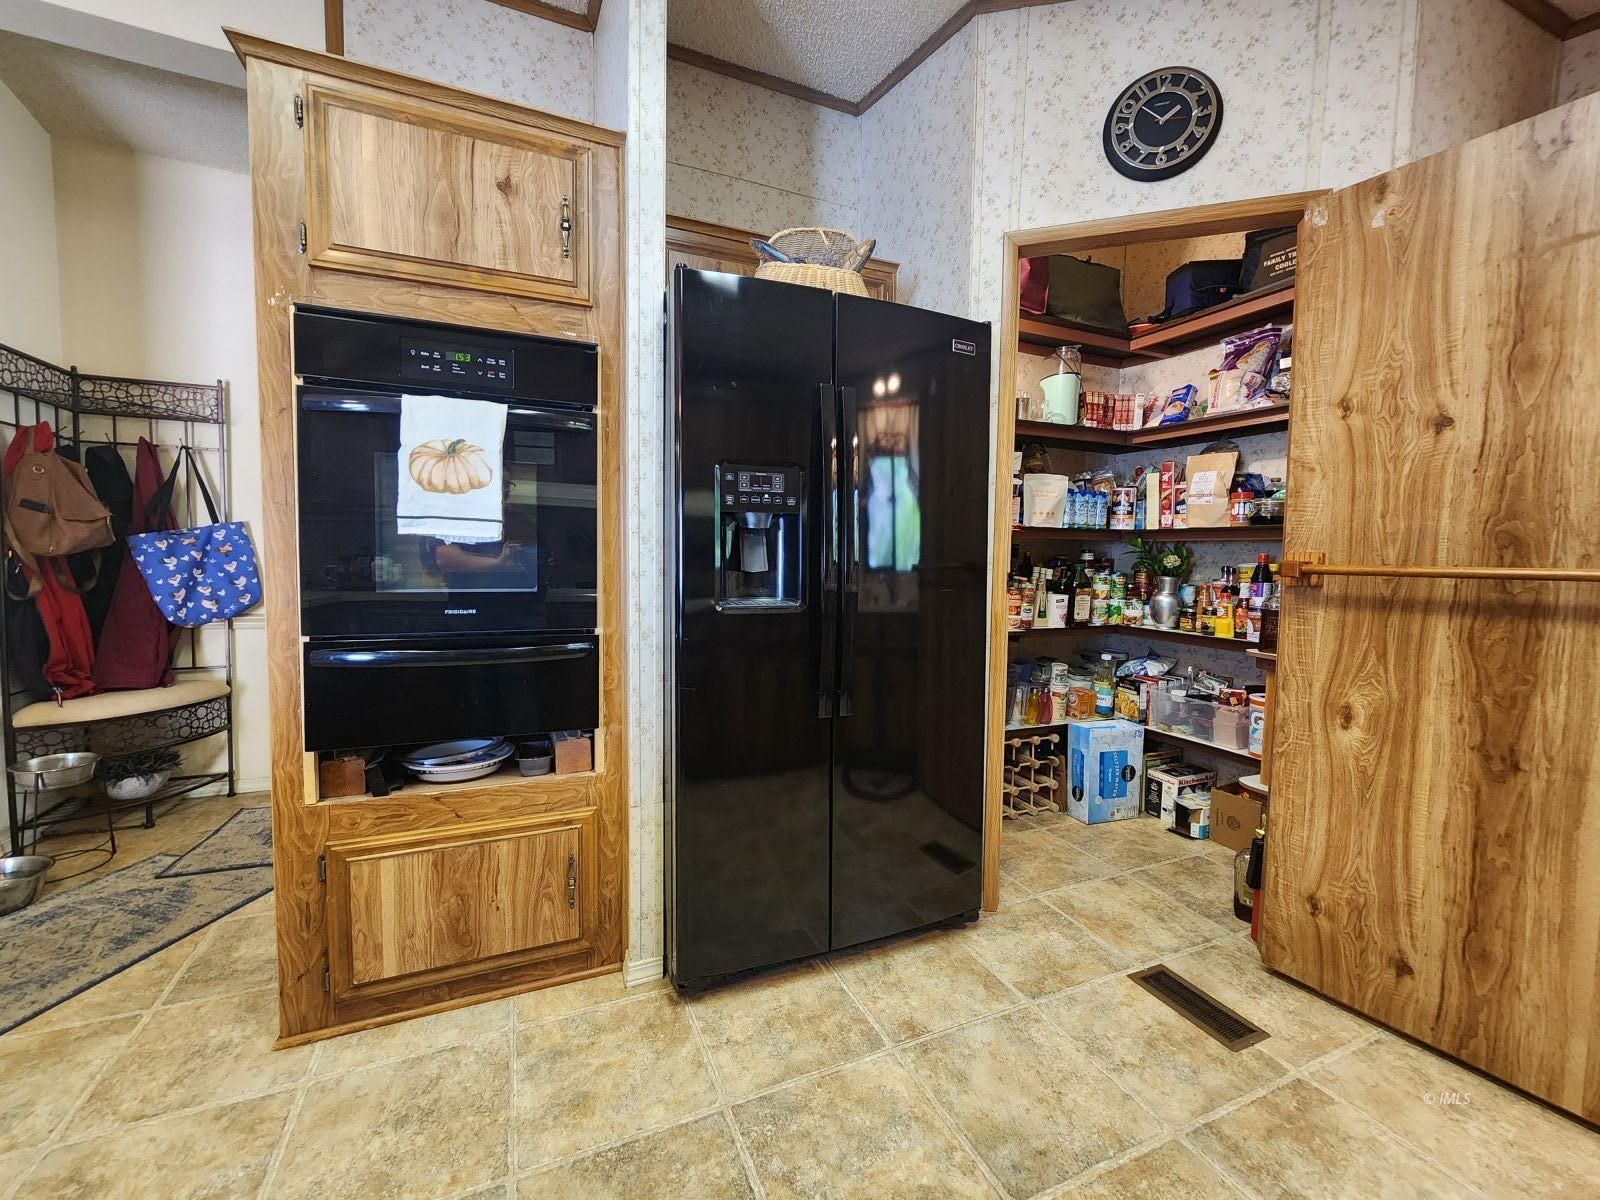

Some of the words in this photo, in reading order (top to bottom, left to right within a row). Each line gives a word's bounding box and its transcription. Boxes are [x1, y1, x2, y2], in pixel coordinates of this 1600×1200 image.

[1134, 79, 1151, 100] 11
[1156, 74, 1173, 93] 12
[1117, 99, 1137, 119] 10
[1115, 122, 1134, 135] 9
[1155, 145, 1168, 165] 6
[1263, 255, 1286, 267] FAMILY
[1178, 773, 1216, 786] KitchenAid
